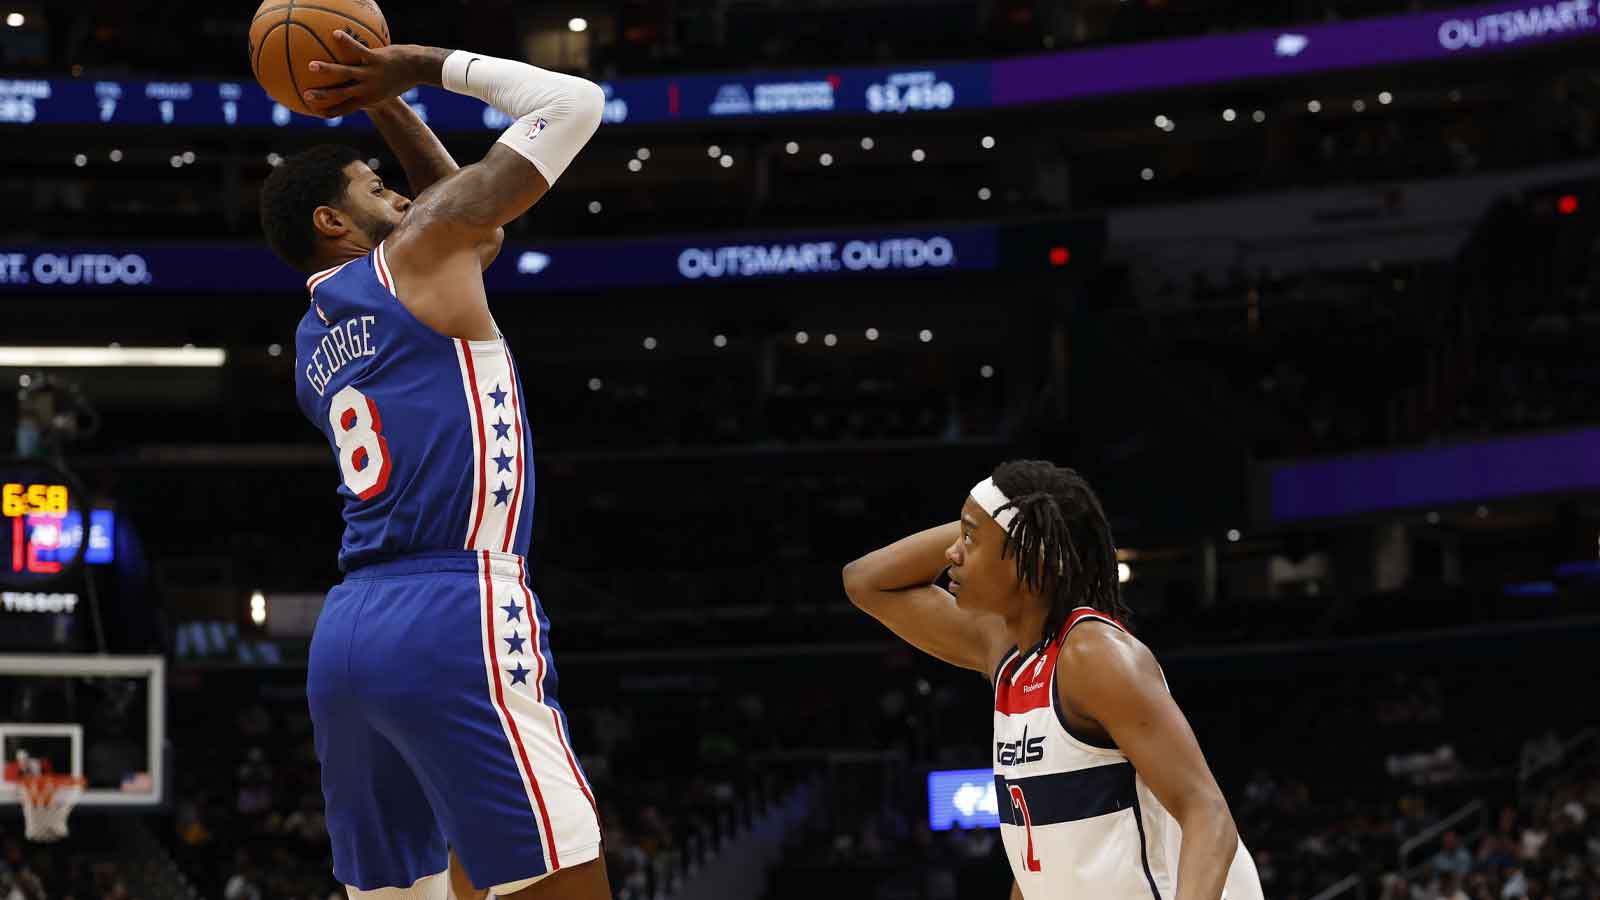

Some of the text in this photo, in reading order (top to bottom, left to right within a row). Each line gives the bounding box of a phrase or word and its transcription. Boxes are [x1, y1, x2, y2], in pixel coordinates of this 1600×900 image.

[1438, 0, 1597, 49] OUTSMART.
[678, 242, 840, 279] OUTSMART.
[306, 315, 376, 397] GEORGE
[328, 384, 393, 501] 8
[2, 483, 69, 518] 6:58
[2, 592, 79, 613] TISSOT
